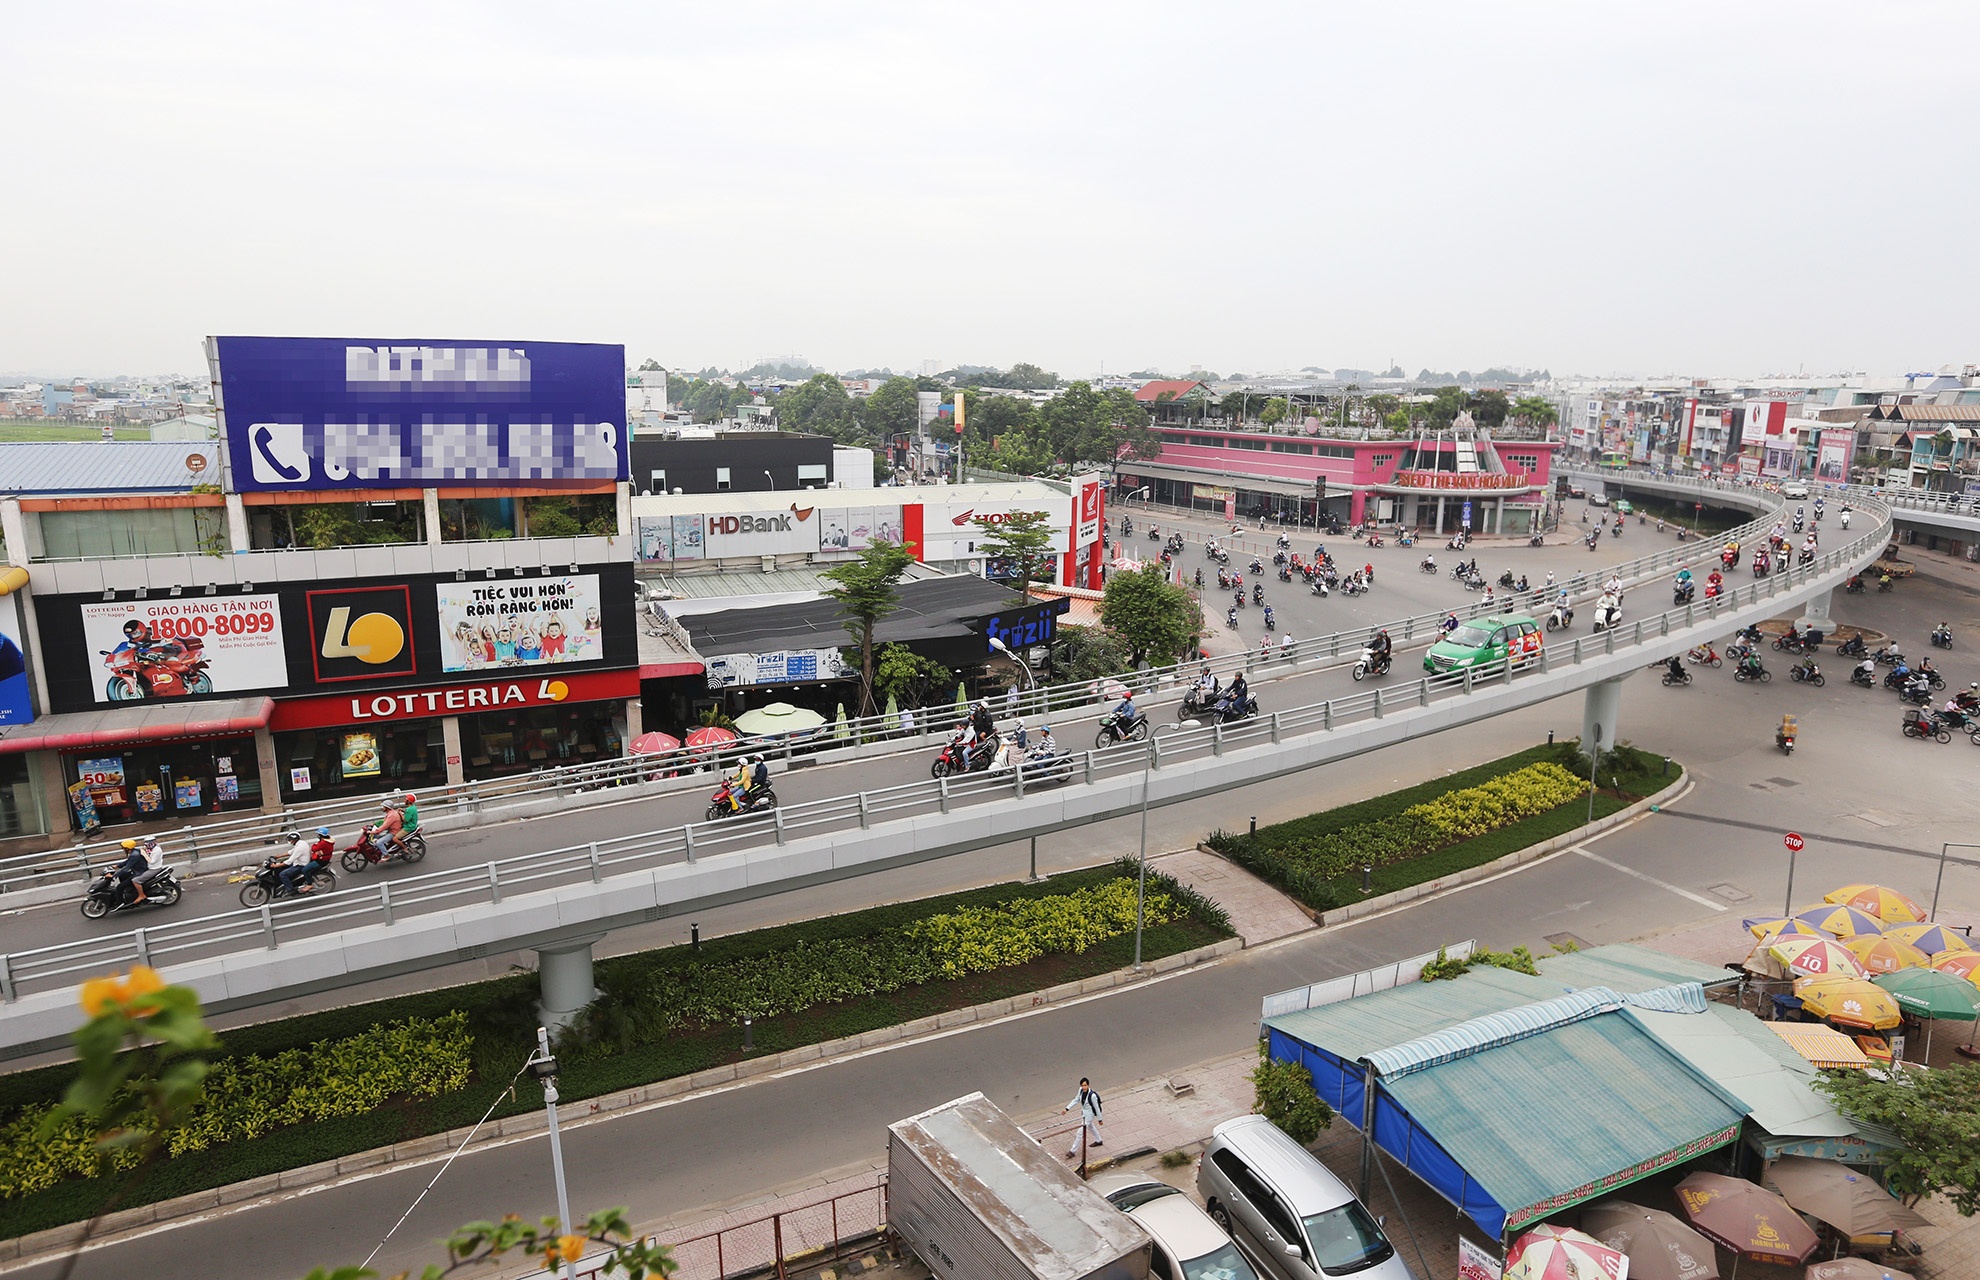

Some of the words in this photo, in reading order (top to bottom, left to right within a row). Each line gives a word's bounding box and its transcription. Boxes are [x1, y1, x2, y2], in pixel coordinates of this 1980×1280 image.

[709, 513, 791, 535] HDBank
[473, 585, 505, 602] TIỆC
[509, 586, 533, 598] VUI
[538, 583, 566, 596] HƠN
[147, 605, 179, 616] GIAO
[183, 602, 218, 614] HÀNG
[222, 600, 246, 614] TẬN
[250, 600, 273, 610] NƠI
[466, 603, 495, 618] RỘN
[499, 600, 537, 614] RÀNG
[149, 612, 275, 640] 1800-8099
[352, 684, 526, 718] LOTTERIA
[1785, 836, 1803, 847] STOP
